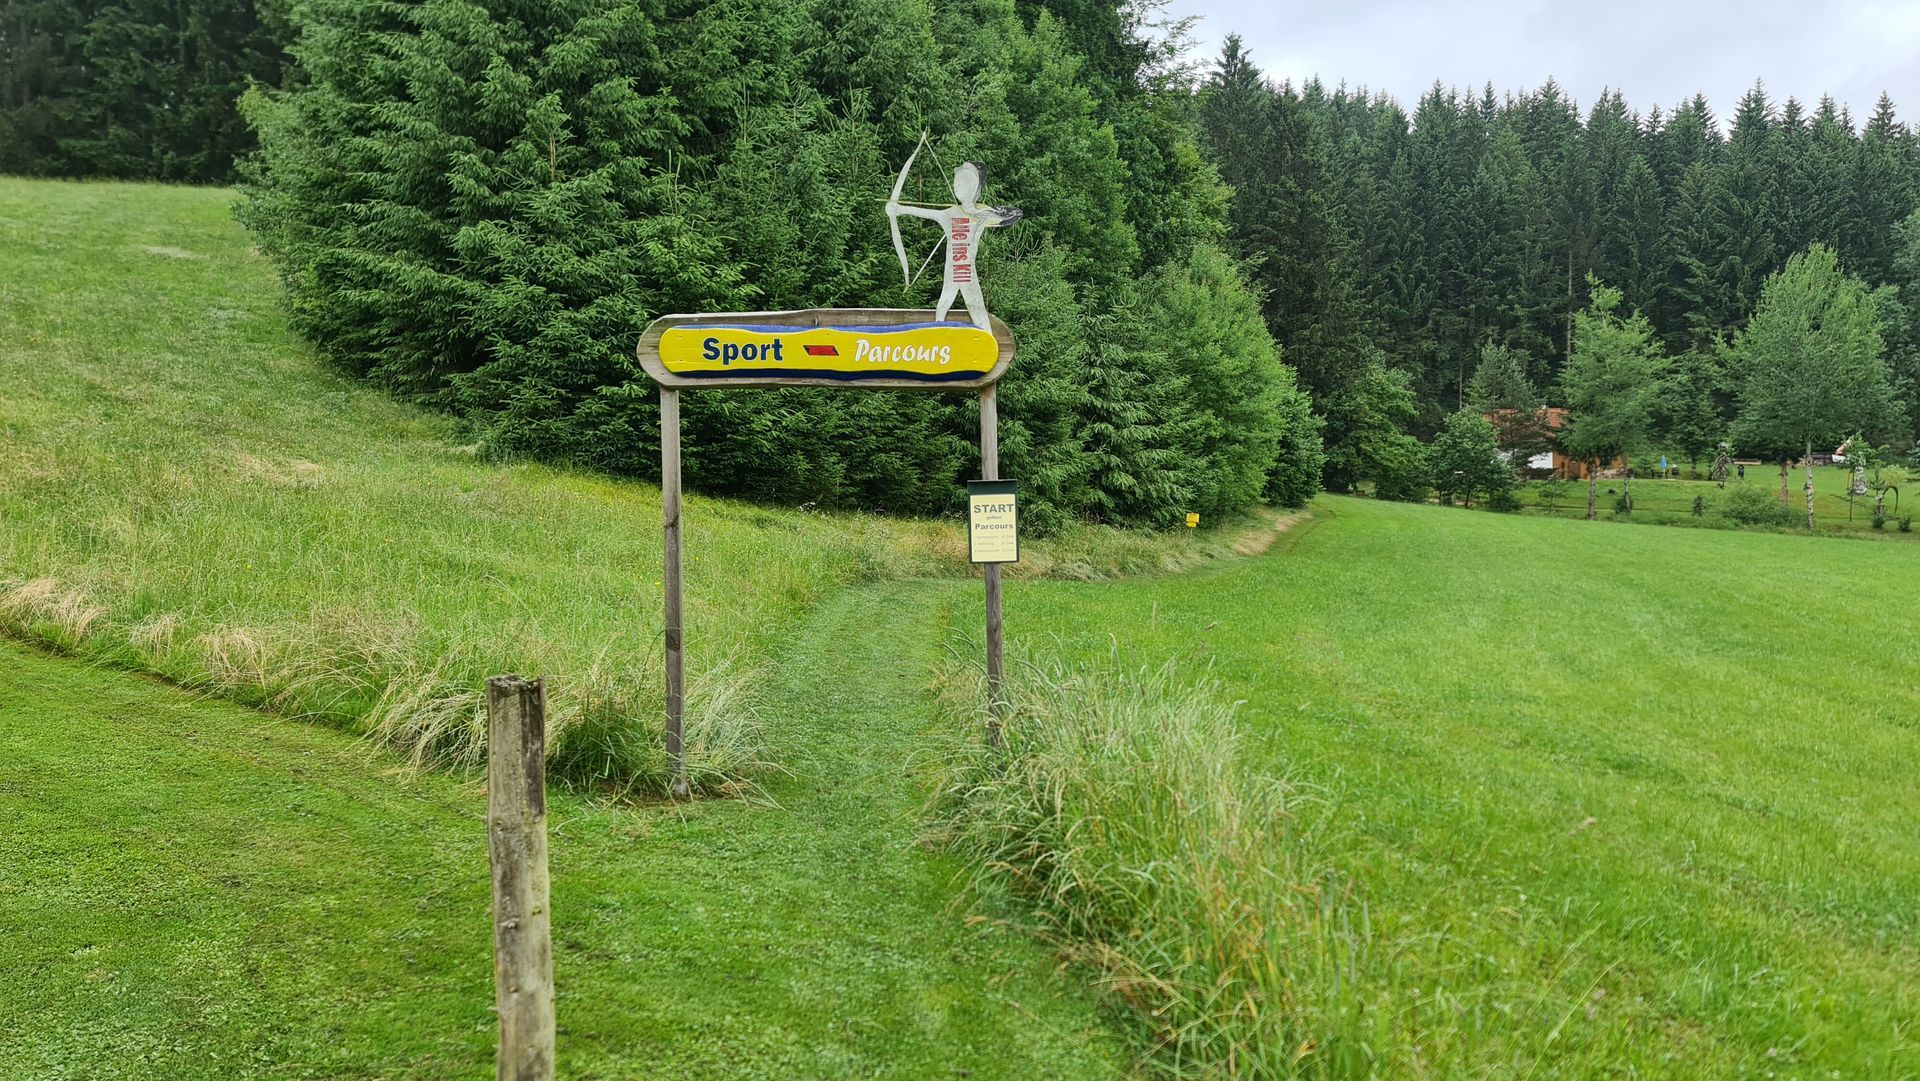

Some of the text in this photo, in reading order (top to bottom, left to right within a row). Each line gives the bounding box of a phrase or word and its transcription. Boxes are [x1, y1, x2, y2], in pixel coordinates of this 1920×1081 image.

[952, 217, 971, 283] Alle ins Kill
[702, 337, 951, 365] Sport Parcours
[974, 504, 1014, 513] START
